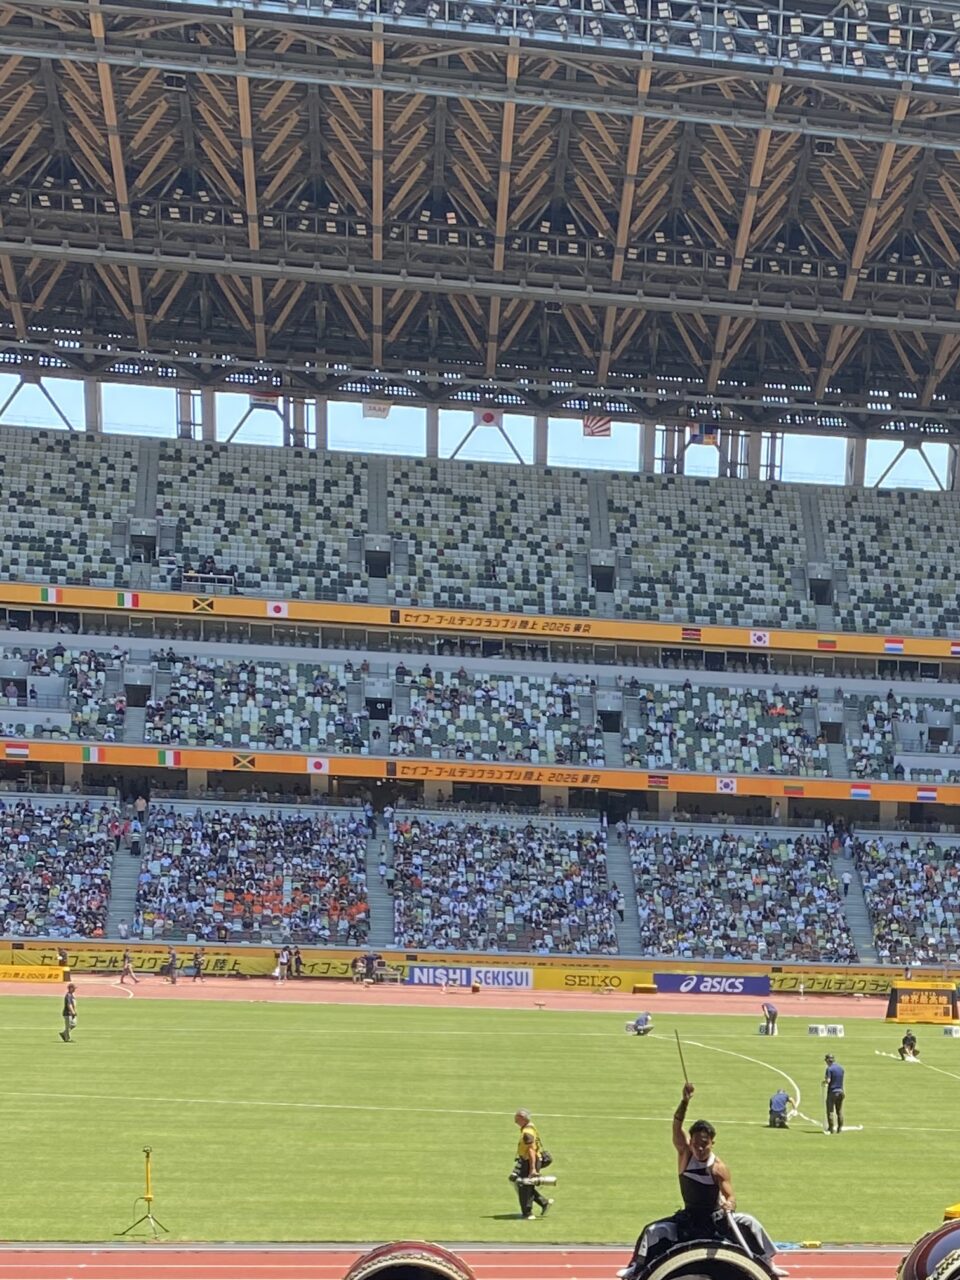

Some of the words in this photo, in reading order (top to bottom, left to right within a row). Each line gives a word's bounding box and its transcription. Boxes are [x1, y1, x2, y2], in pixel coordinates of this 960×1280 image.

[542, 621, 570, 631] 2026
[548, 772, 579, 783] 2026
[413, 968, 468, 985] NISHI
[475, 970, 530, 986] SEKISUI
[565, 974, 622, 987] SEIKO
